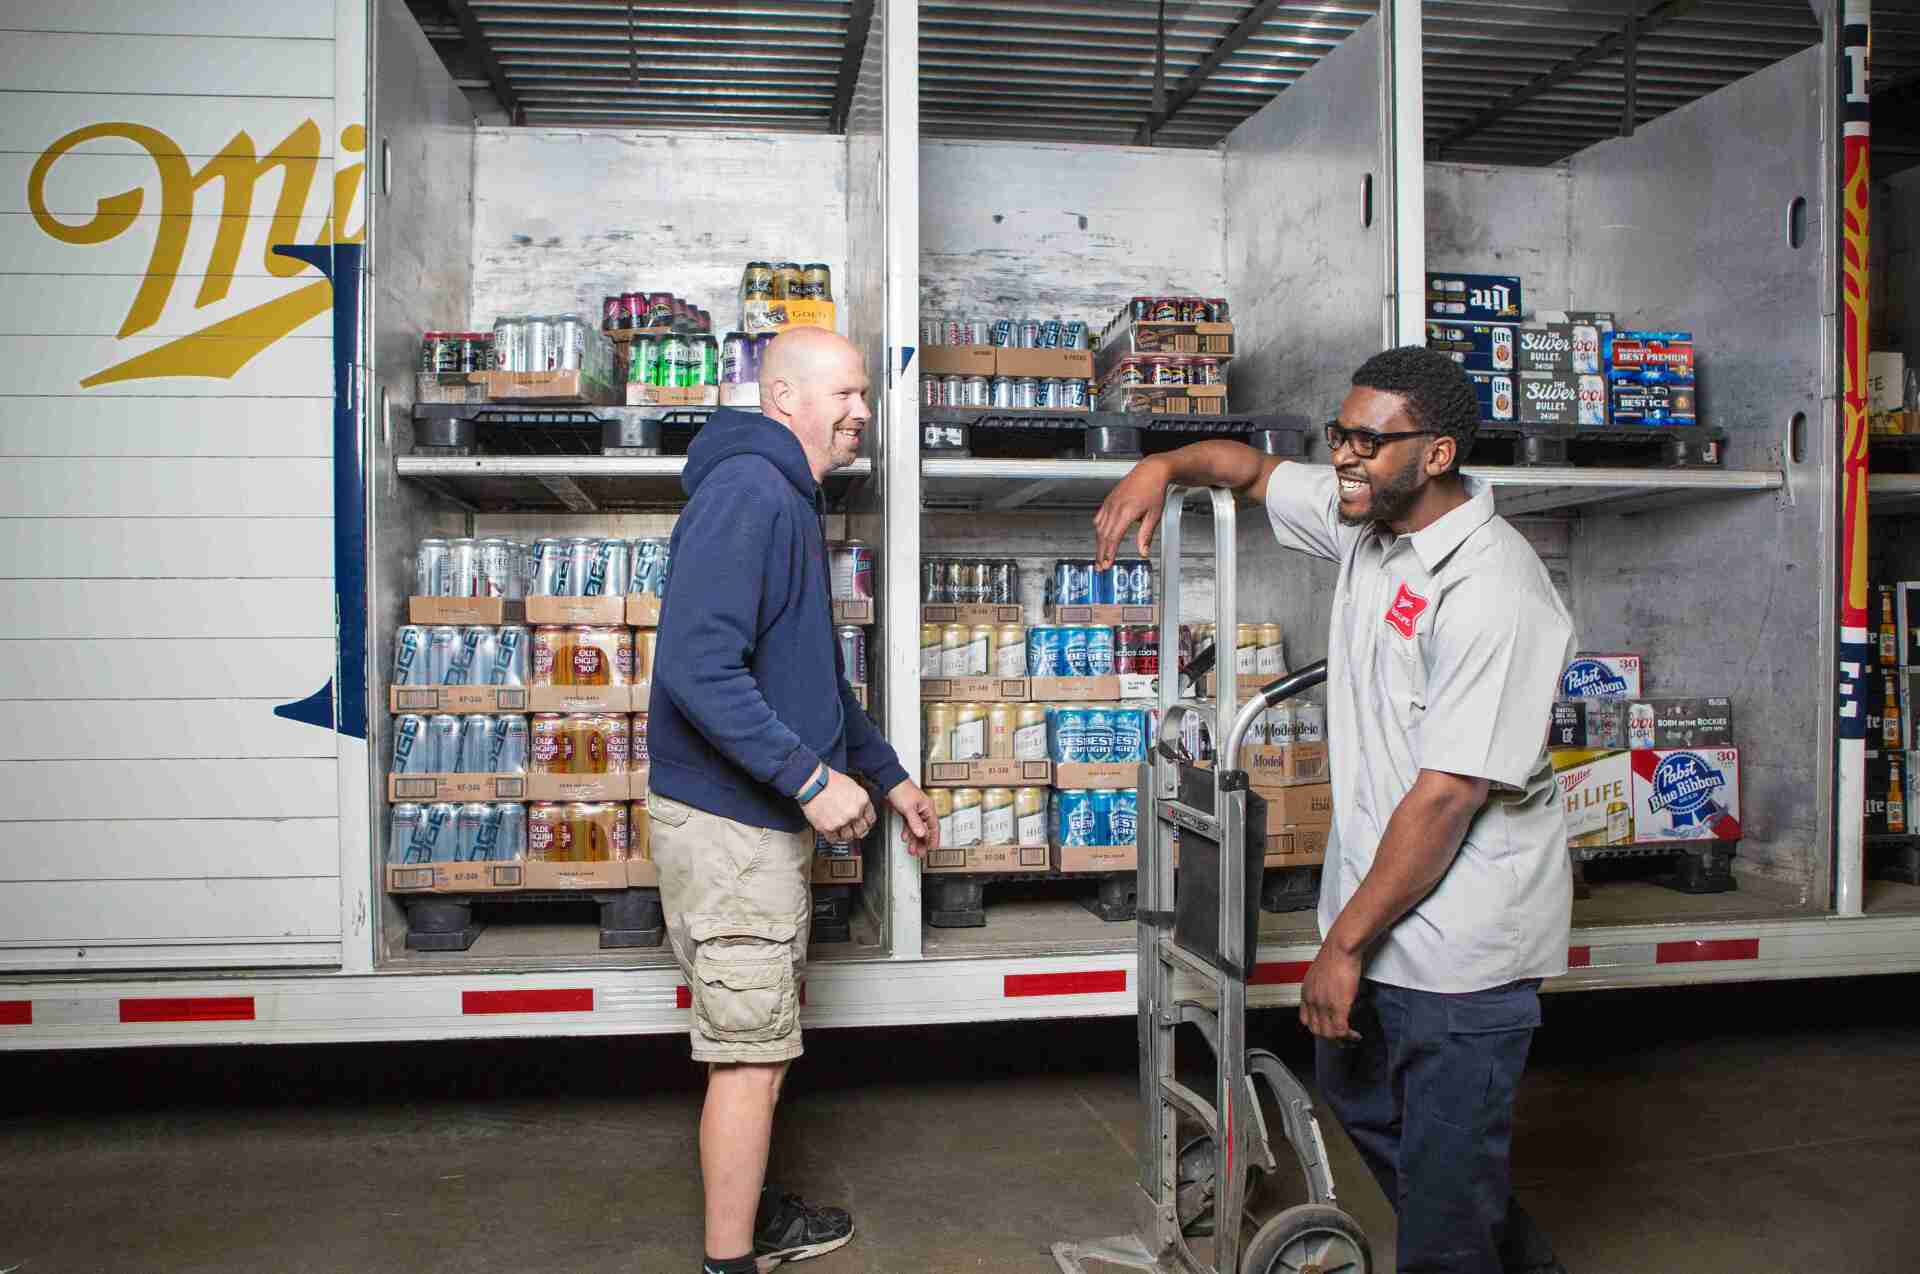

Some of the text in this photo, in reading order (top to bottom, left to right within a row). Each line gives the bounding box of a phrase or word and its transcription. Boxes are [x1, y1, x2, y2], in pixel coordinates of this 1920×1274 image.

[1521, 332, 1571, 351] Silver
[1619, 352, 1689, 362] BEST PREMIUM
[1526, 382, 1577, 401] Silver
[1564, 666, 1600, 691] Pabst
[1582, 680, 1625, 698] Ribbon
[1717, 751, 1735, 761] 30
[1659, 759, 1697, 788] Pabst
[1584, 779, 1624, 807] LIFE
[1649, 774, 1722, 815] Blue Ribbon
